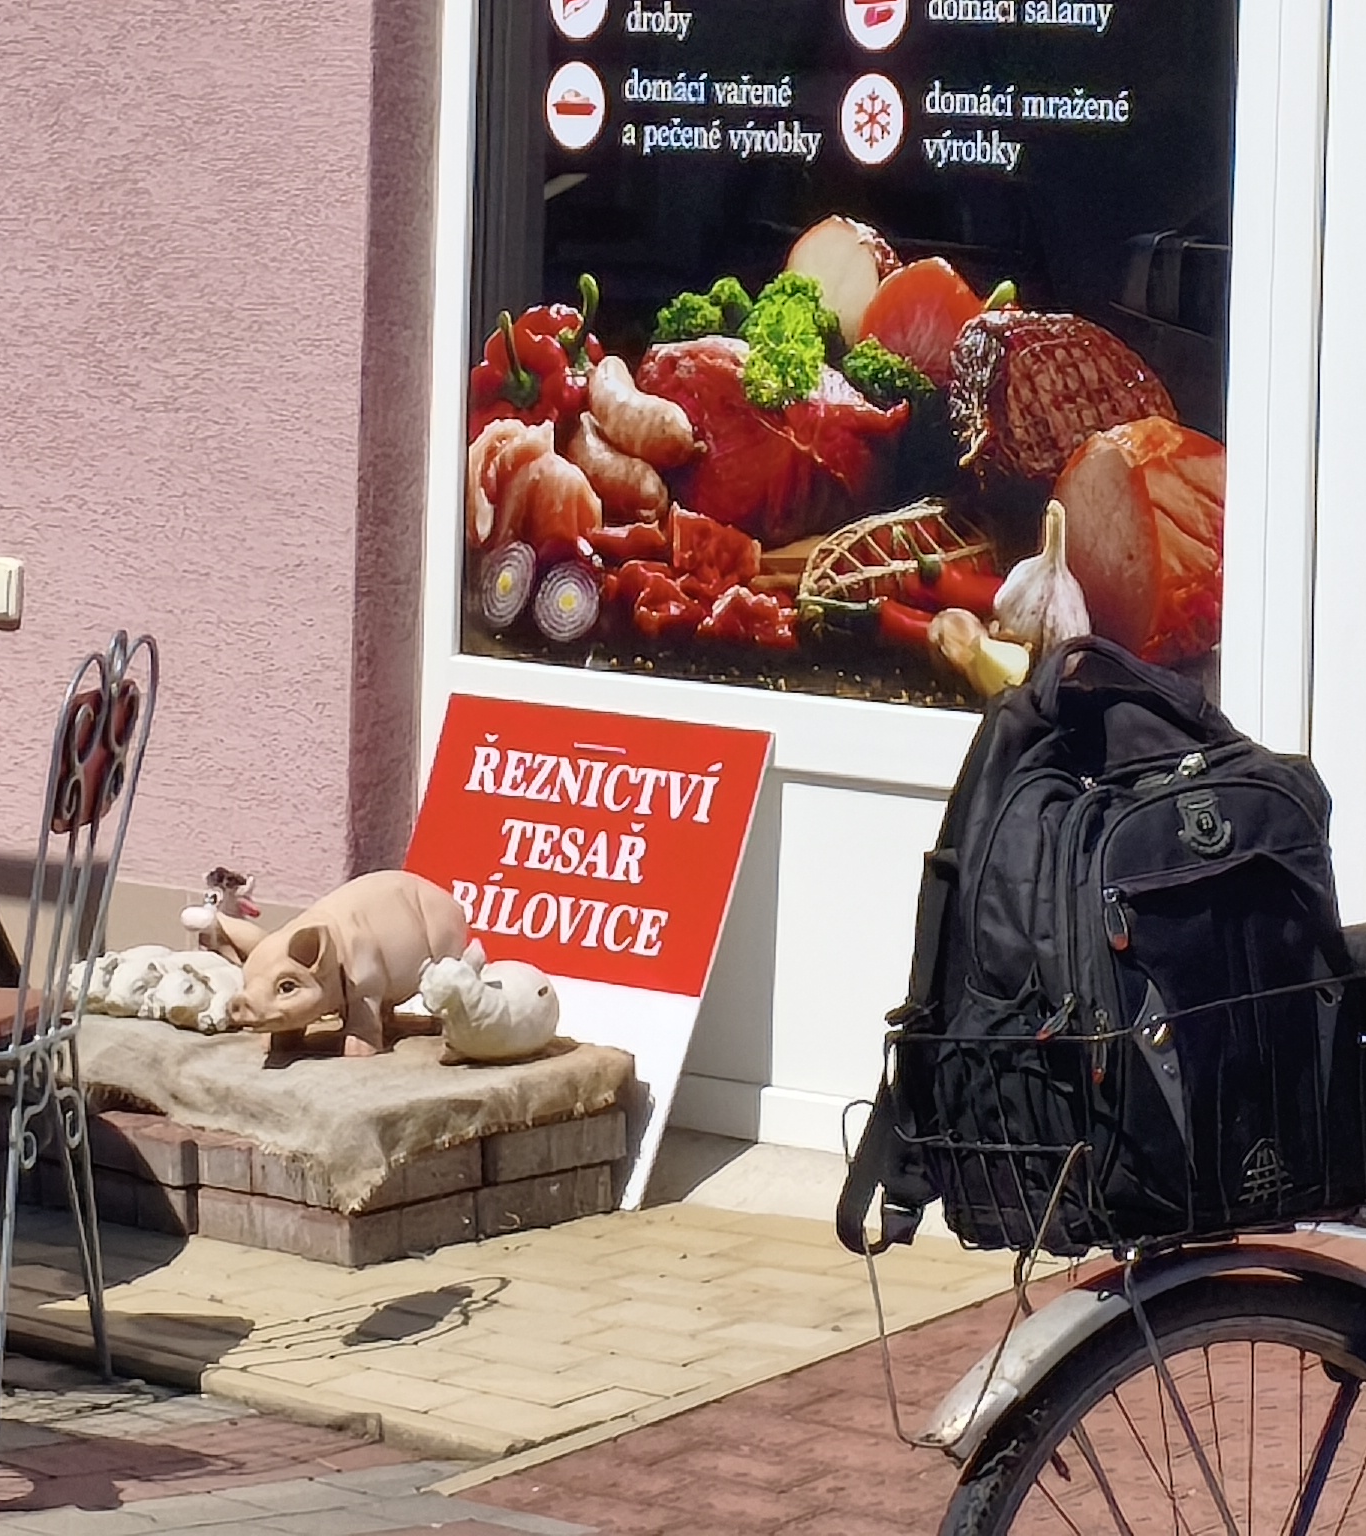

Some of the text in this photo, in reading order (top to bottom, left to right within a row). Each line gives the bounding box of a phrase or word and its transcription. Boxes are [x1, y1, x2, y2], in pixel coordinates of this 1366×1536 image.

[625, 3, 693, 42] droby
[624, 67, 793, 108] domácí vařené
[925, 81, 1129, 123] domácí mražené
[621, 117, 822, 161] a pečené výrobky
[922, 131, 1021, 171] výrobky
[464, 733, 723, 823] ŘEZNICTVÍ
[500, 818, 647, 884] TESAŘ
[451, 873, 668, 956] BÍLOVICE
